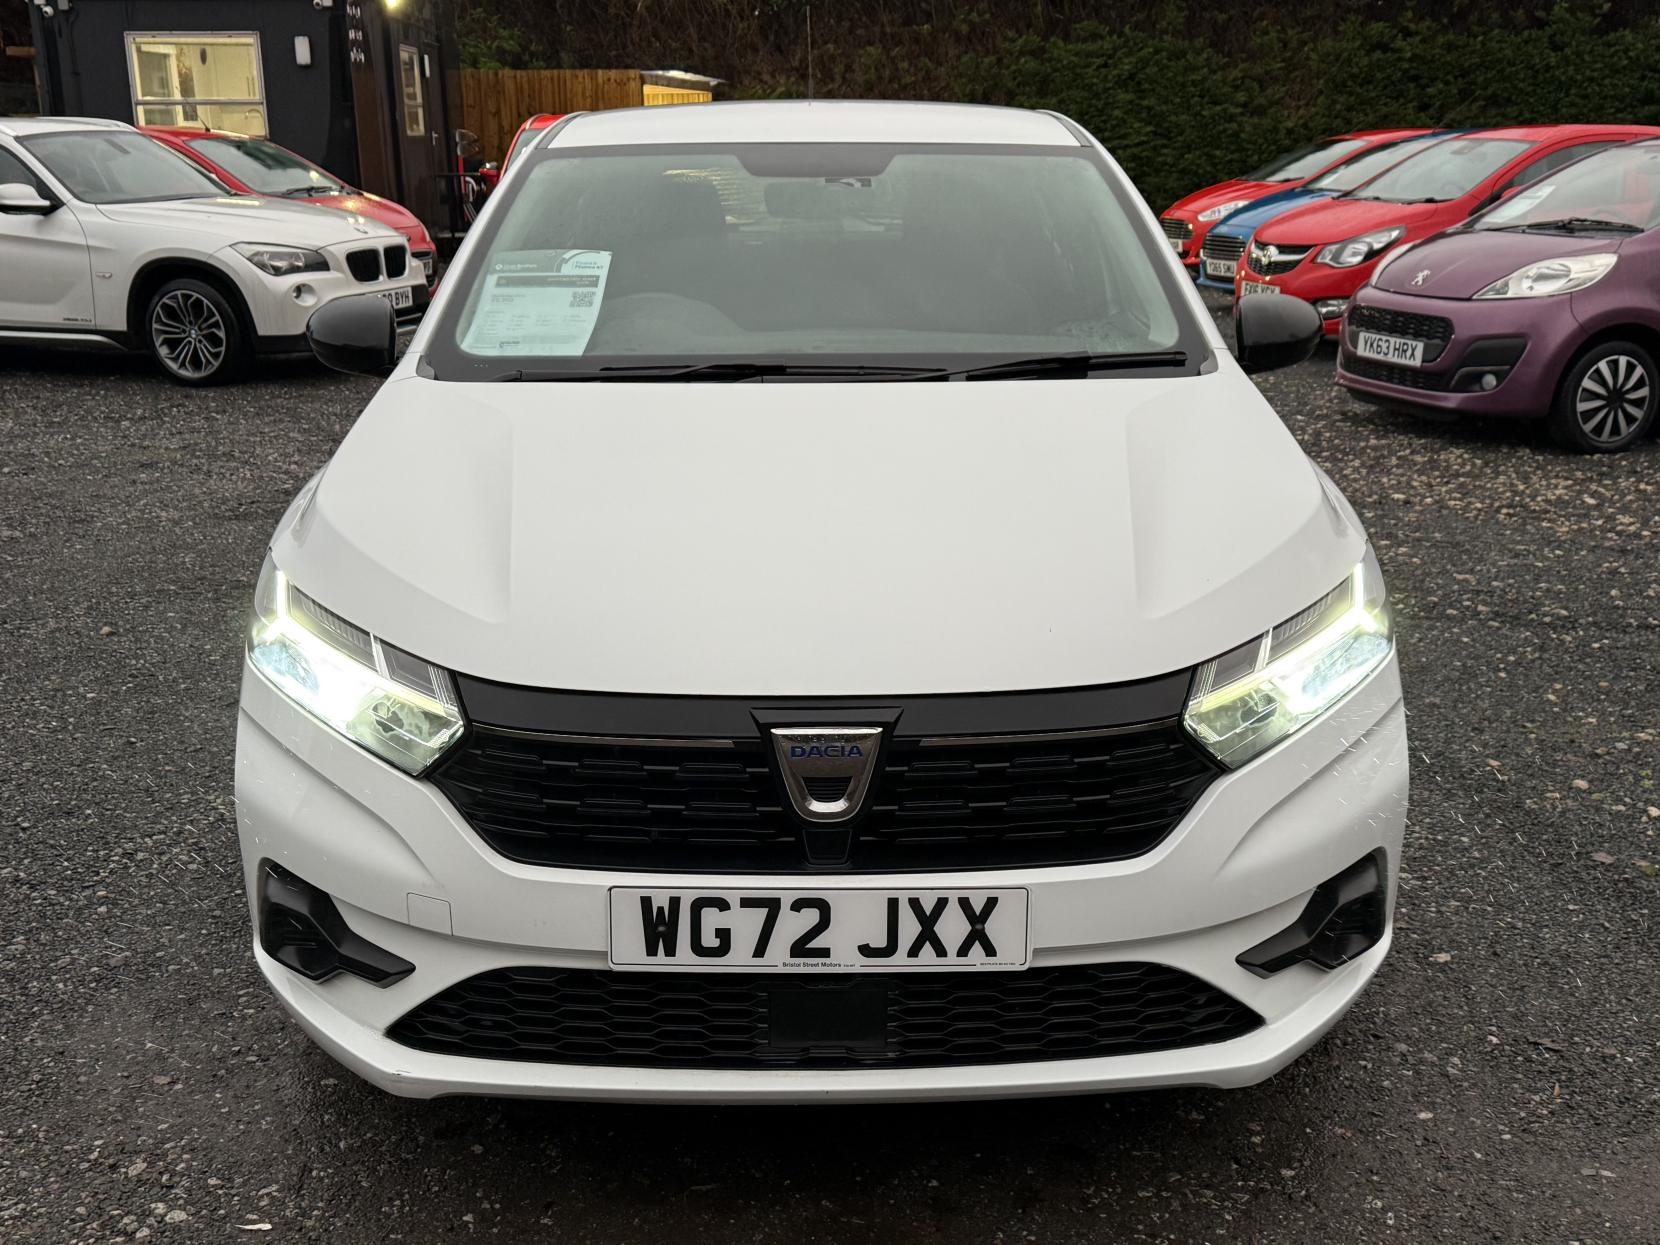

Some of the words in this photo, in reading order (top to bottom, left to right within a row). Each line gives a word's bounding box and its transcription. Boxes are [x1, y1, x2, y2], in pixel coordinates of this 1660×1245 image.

[395, 290, 409, 305] BYH
[1363, 334, 1391, 356] YK63
[1392, 340, 1418, 362] HRX
[789, 745, 864, 758] DACIA
[640, 895, 831, 958] WG72
[858, 897, 999, 958] JXX
